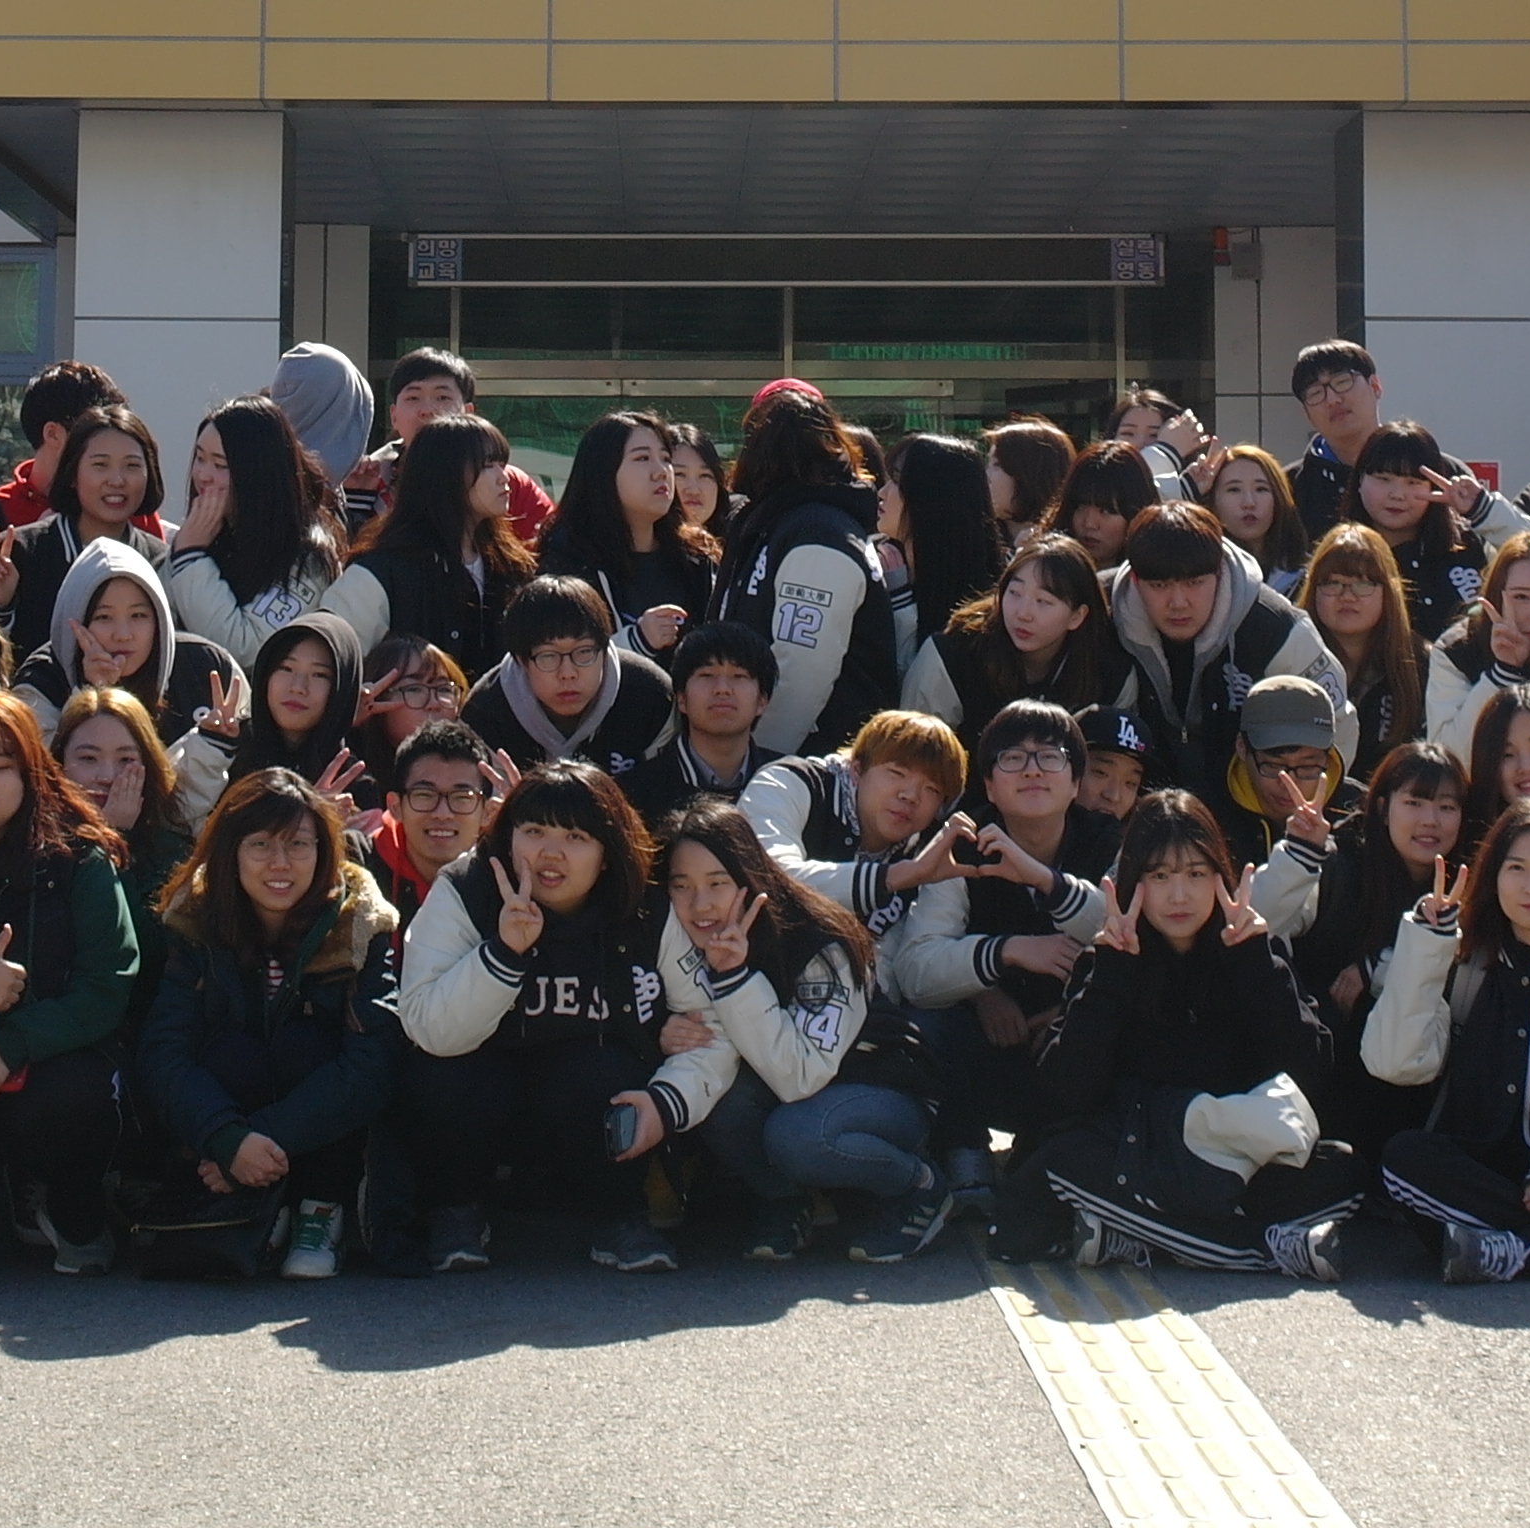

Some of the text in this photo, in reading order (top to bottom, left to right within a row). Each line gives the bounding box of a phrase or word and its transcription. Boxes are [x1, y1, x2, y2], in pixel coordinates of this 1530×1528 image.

[416, 238, 457, 259] 희망
[1116, 238, 1155, 258] 실력
[416, 260, 457, 281] 교육
[1116, 260, 1156, 281] 영동
[777, 602, 825, 649] 12
[1117, 715, 1140, 751] LA
